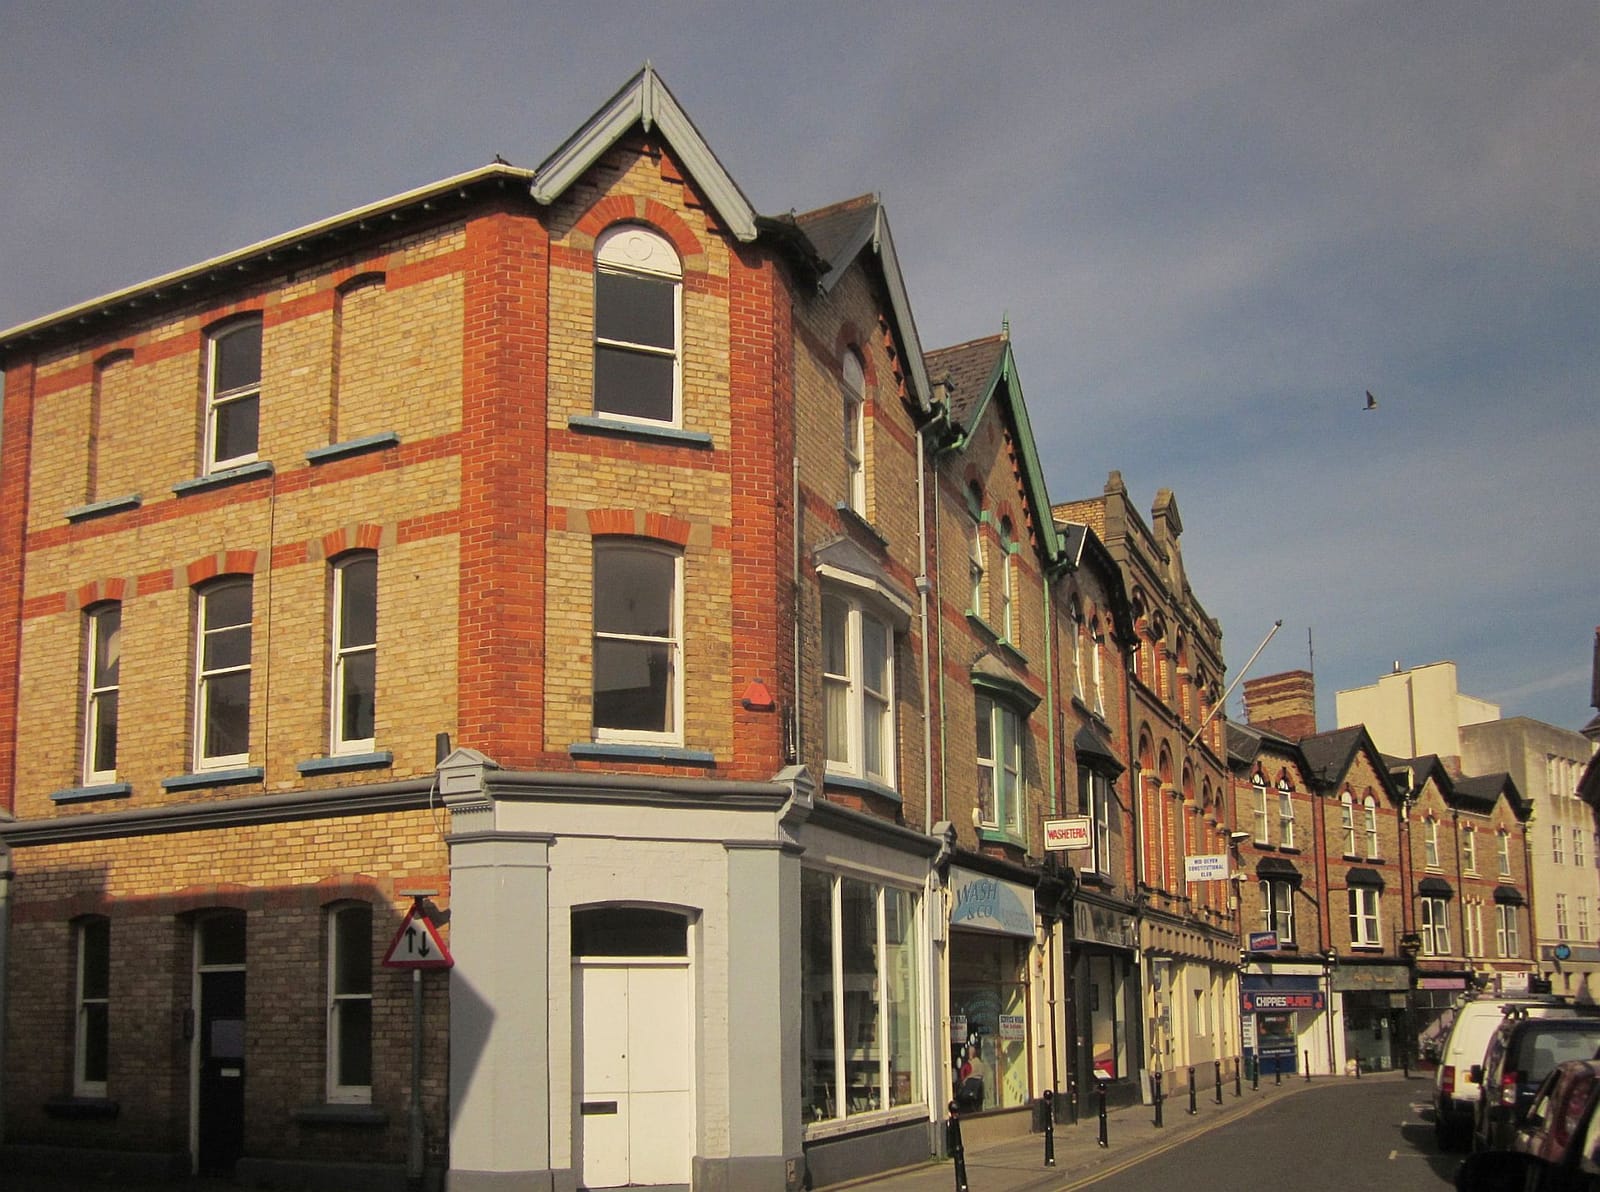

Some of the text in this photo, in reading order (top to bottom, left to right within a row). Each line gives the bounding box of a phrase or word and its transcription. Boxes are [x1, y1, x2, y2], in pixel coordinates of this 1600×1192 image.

[1047, 827, 1087, 840] WASHETERIA
[957, 880, 998, 907] WASH
[967, 908, 975, 920] &
[977, 905, 993, 919] CO
